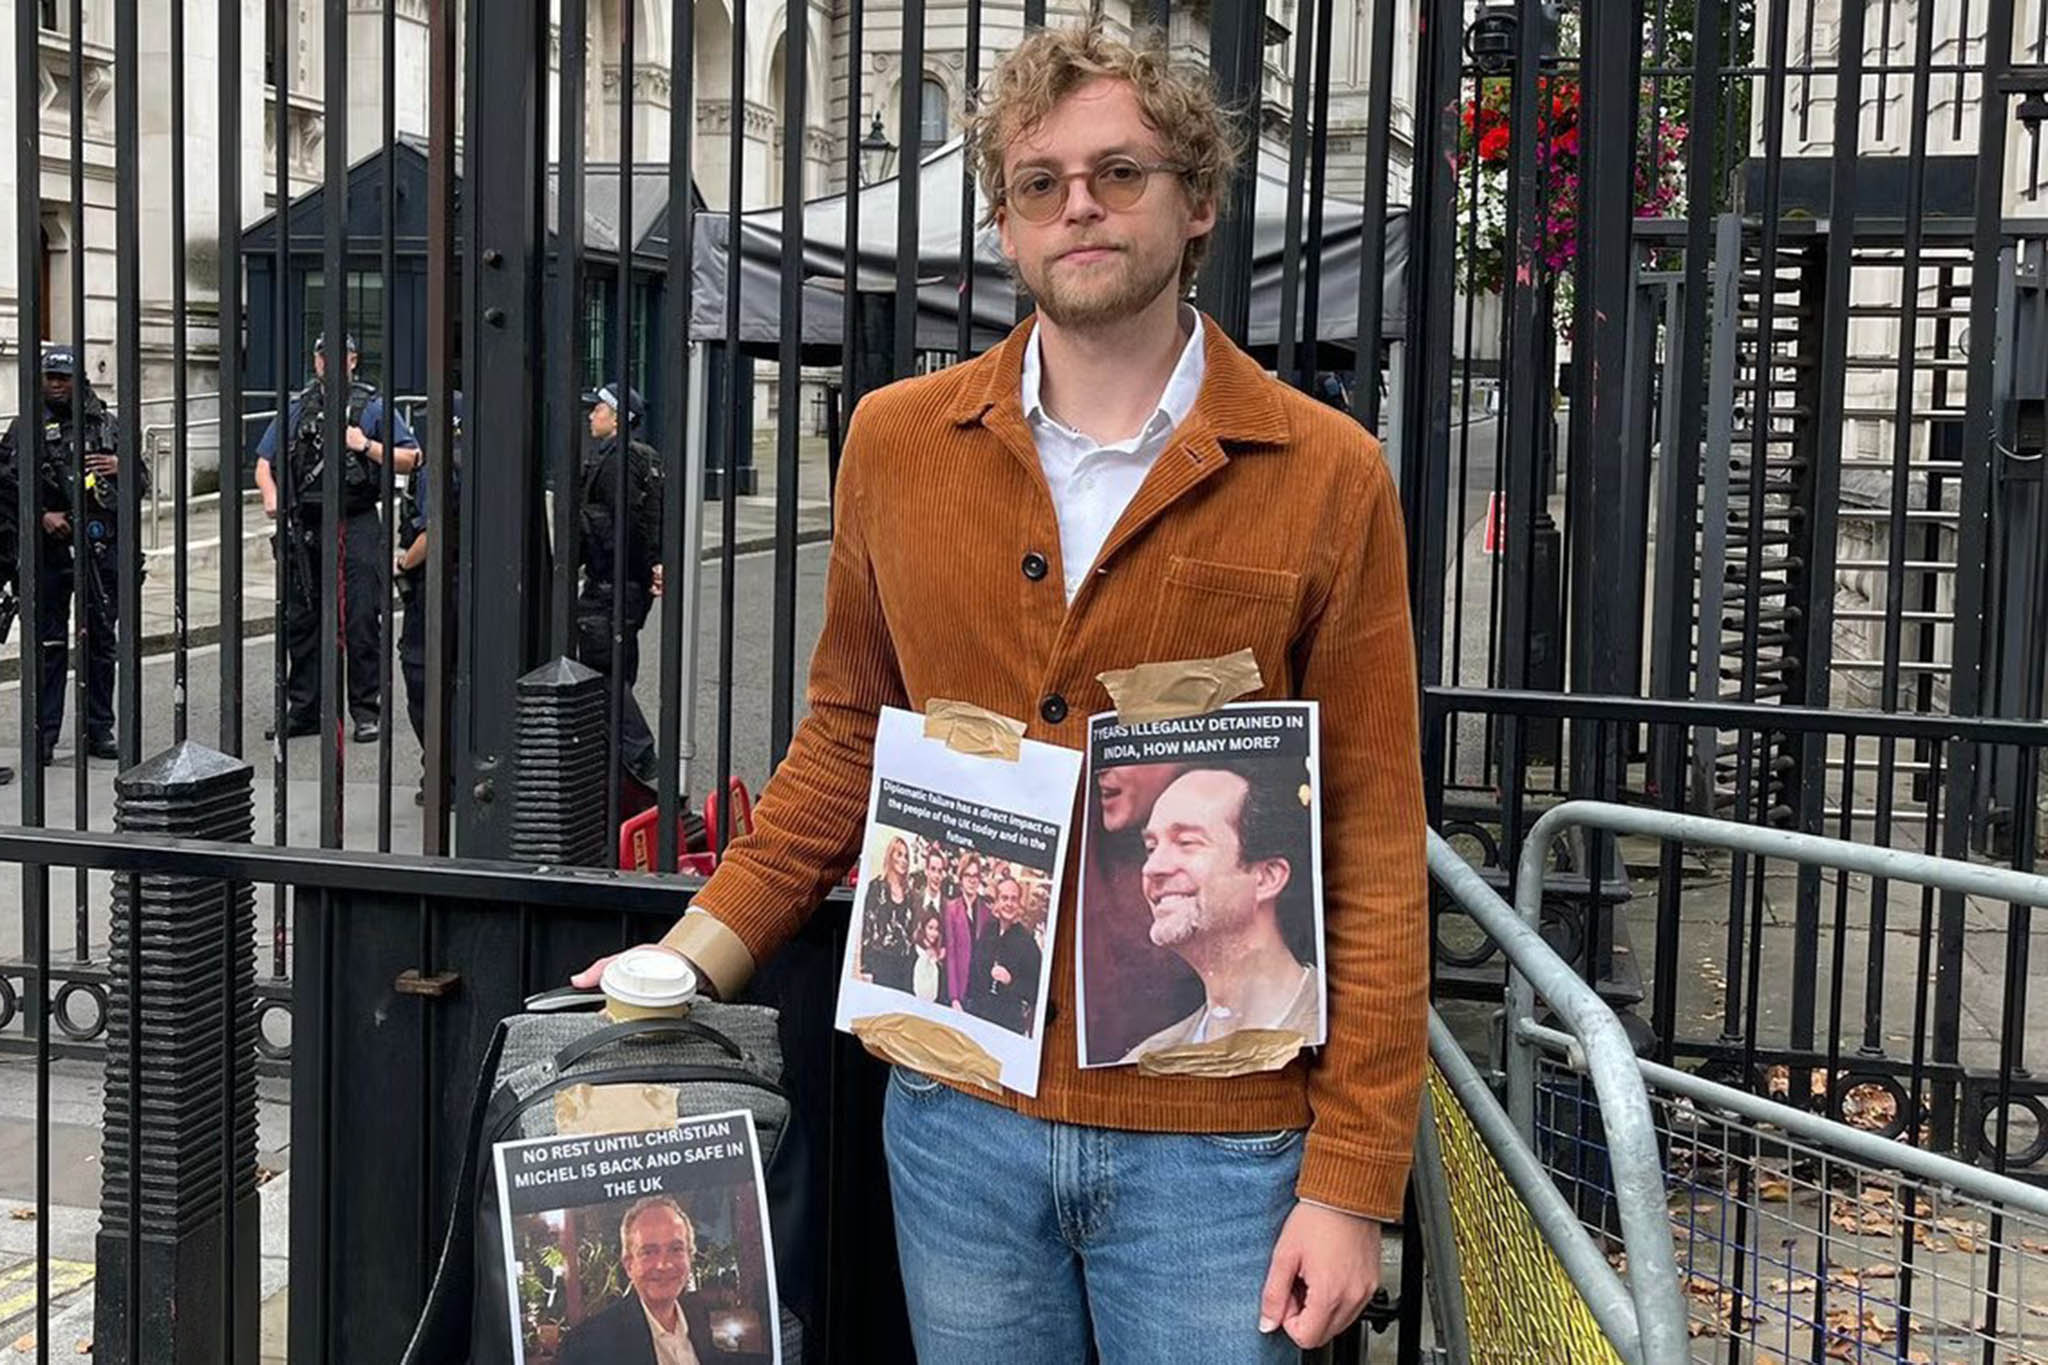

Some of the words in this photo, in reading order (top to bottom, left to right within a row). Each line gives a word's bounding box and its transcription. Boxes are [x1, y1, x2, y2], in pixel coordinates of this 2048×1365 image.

[1131, 718, 1205, 736] ILLEGALLY
[1208, 716, 1283, 732] DETAINED
[1286, 715, 1303, 729] IN
[1103, 743, 1141, 760] INDIA,
[1143, 741, 1180, 756] HOW
[1183, 738, 1227, 754] MANY
[1229, 735, 1280, 751] MORE?
[883, 780, 927, 801] Diplomatic
[928, 792, 955, 810] failure
[956, 801, 972, 815] has
[980, 808, 1009, 824] direct
[1009, 814, 1042, 833] impact
[1042, 825, 1057, 837] on
[888, 798, 902, 811] the
[903, 803, 932, 819] people
[932, 811, 942, 821] of
[942, 813, 957, 827] the
[958, 817, 972, 830] UK
[971, 822, 998, 840] today
[999, 831, 1018, 843] and
[1019, 833, 1029, 846] in
[1030, 837, 1047, 851] the
[946, 829, 975, 848] future.
[523, 1149, 548, 1164] NO
[551, 1142, 590, 1159] REST
[594, 1136, 642, 1155] UNTIL
[645, 1122, 731, 1146] CHRISTIAN
[515, 1166, 579, 1188] MICHEL
[581, 1162, 597, 1178] IS
[600, 1156, 644, 1176] BACK
[646, 1151, 682, 1169] AND
[684, 1144, 724, 1164] SAFE
[726, 1141, 744, 1157] IN
[603, 1180, 637, 1198] THE
[640, 1176, 664, 1193] UK
